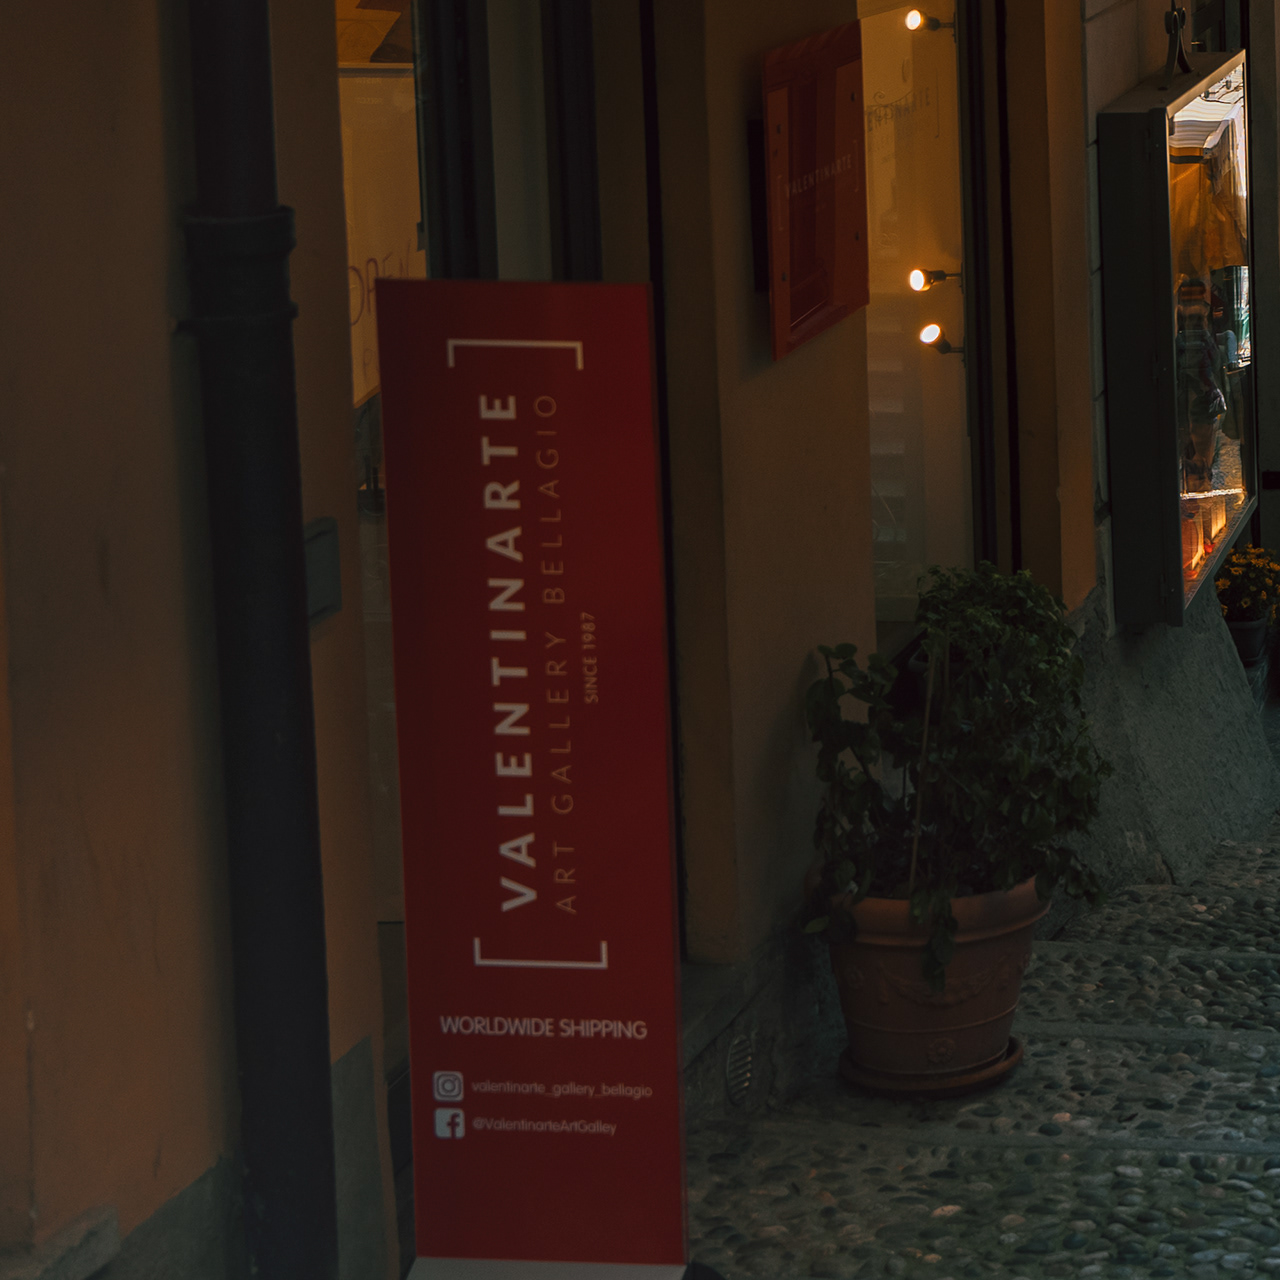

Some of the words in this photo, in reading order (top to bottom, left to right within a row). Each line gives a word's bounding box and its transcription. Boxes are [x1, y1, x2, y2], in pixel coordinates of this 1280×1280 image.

[533, 394, 566, 605] BELLAGIO
[478, 393, 538, 913] VALENTINARTE
[579, 611, 597, 650] 1987
[581, 655, 599, 705] SINCE
[544, 630, 575, 815] GALLERY
[553, 840, 577, 916] ART
[439, 1015, 555, 1037] WORLDWIDE
[558, 1018, 648, 1040] SHIPPING
[471, 1079, 654, 1100] valentinarte_gallery_bellagio
